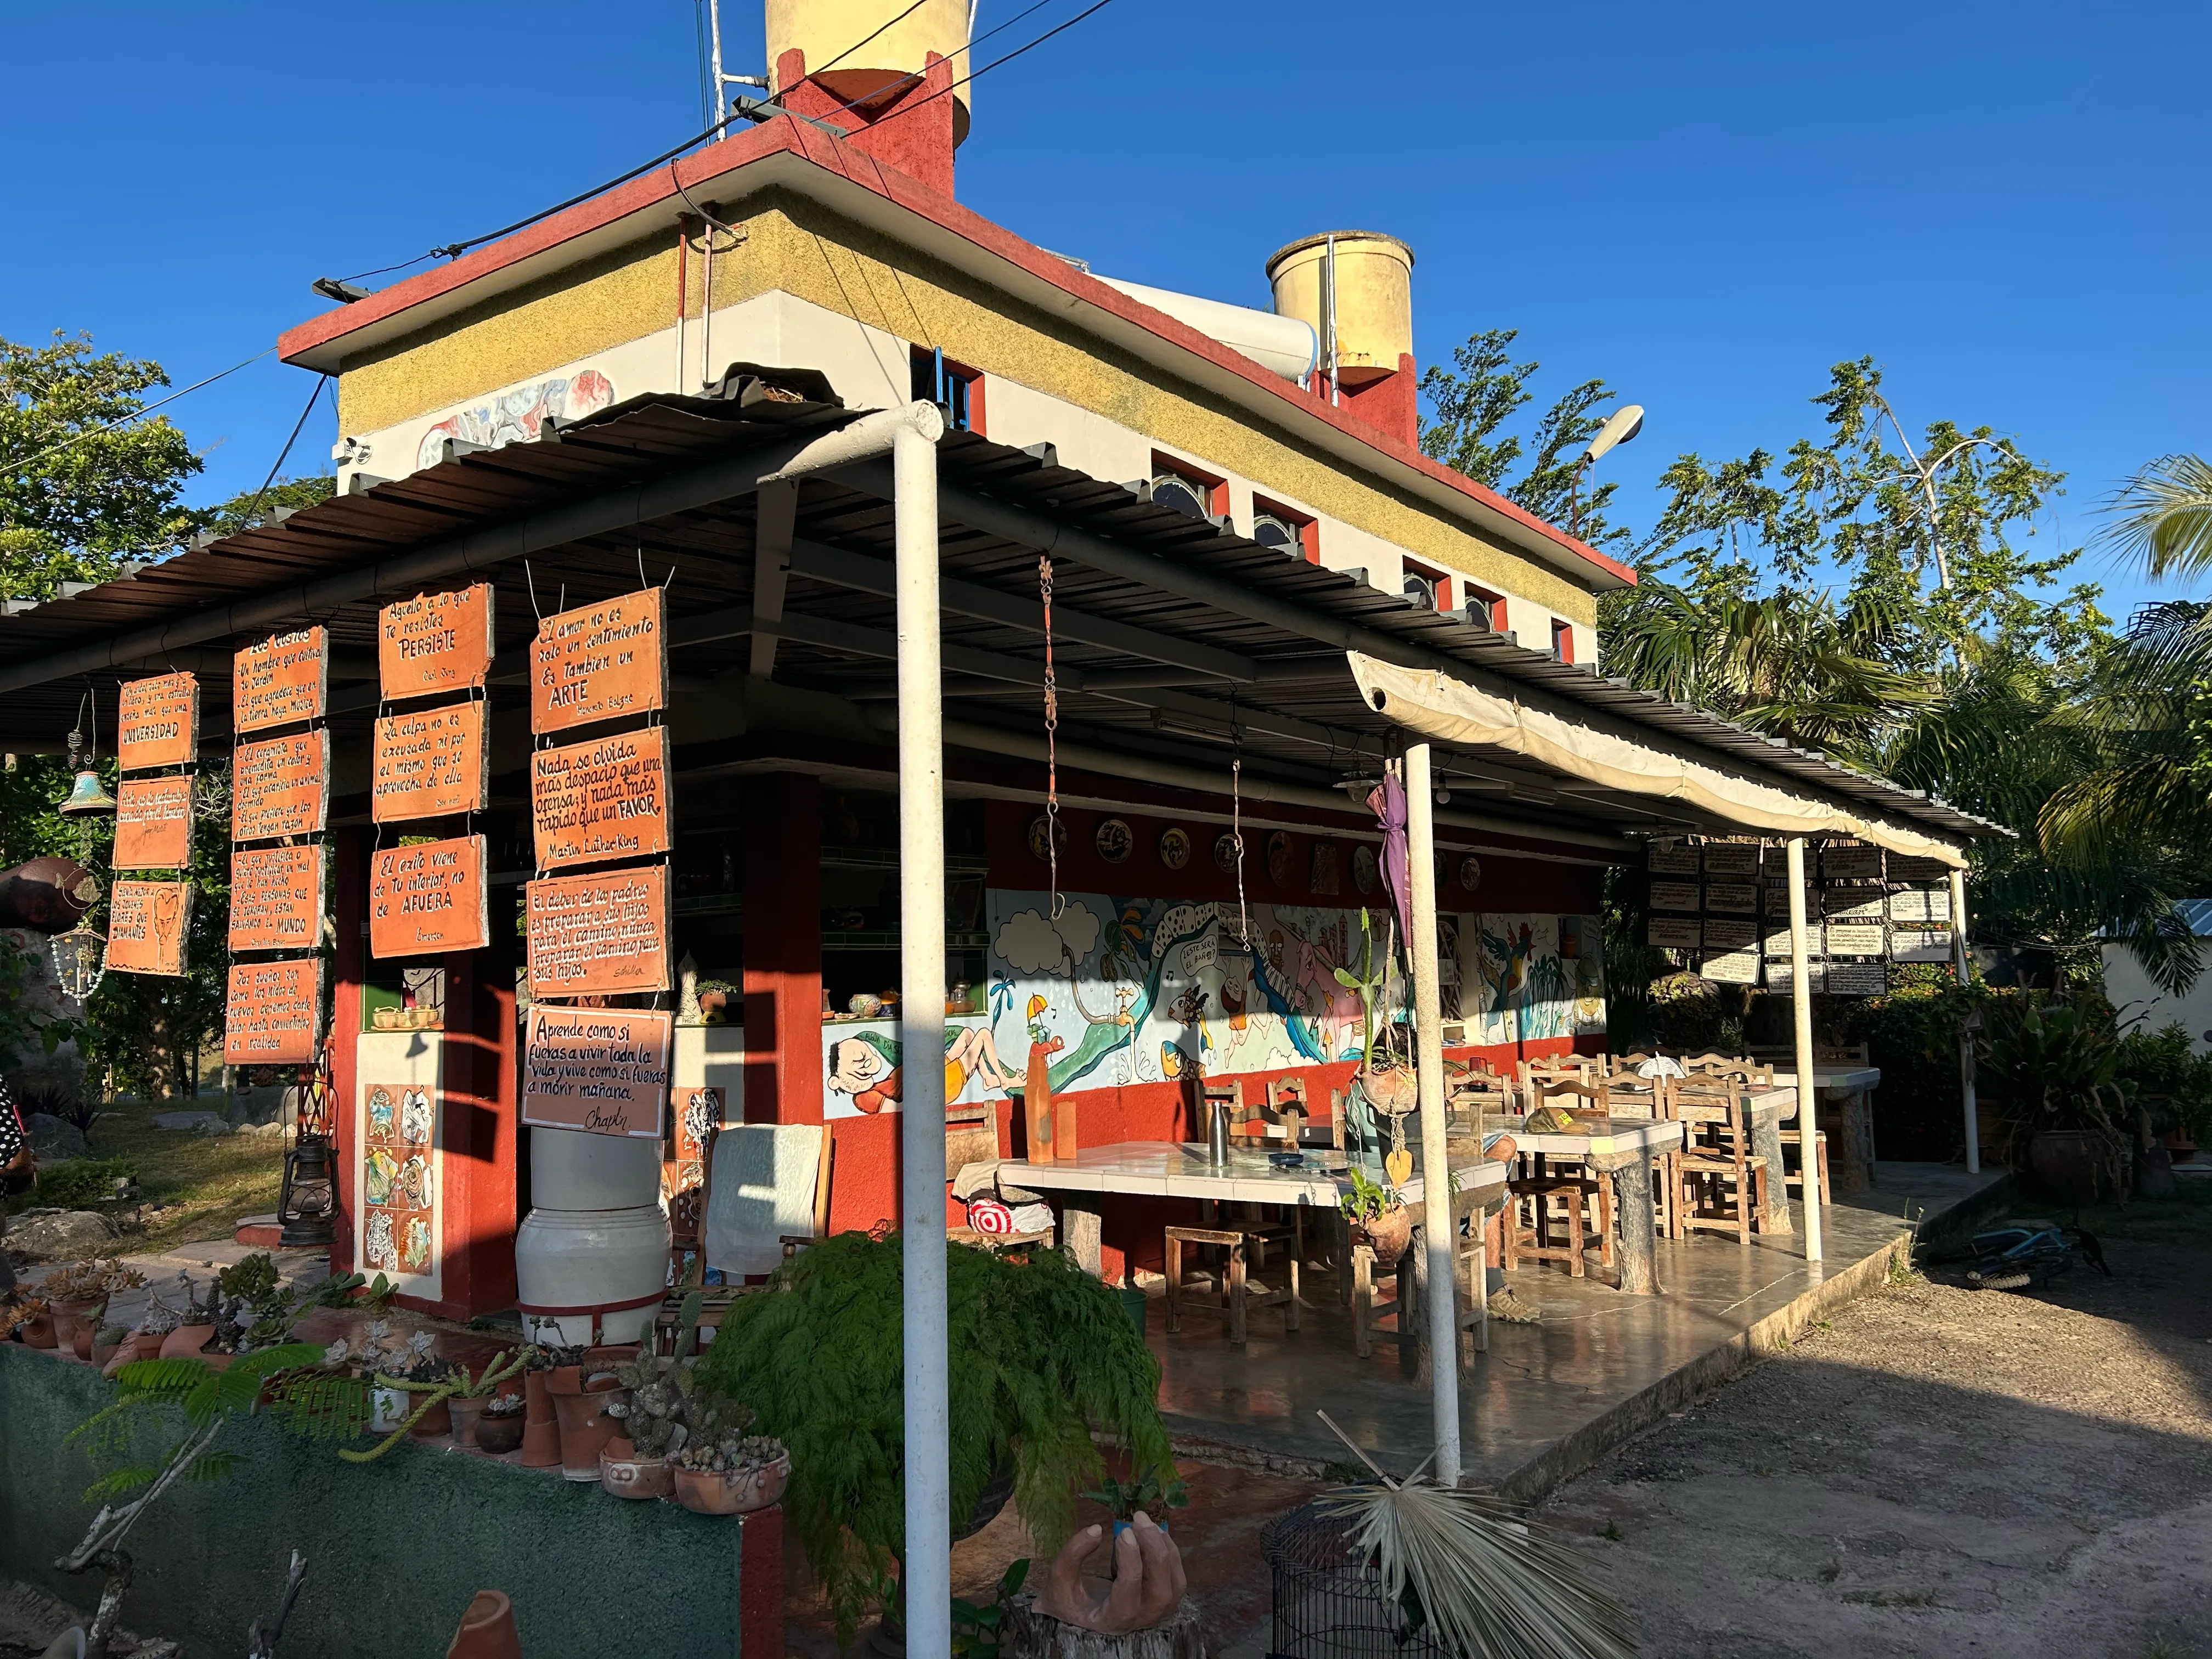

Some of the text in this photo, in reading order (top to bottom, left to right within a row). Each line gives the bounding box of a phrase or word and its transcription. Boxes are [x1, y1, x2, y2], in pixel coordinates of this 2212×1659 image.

[388, 591, 470, 622] Aquello a lo que
[402, 612, 443, 635] resistes
[557, 618, 585, 639] amor
[590, 613, 603, 628] no
[608, 608, 621, 624] es
[397, 629, 455, 661] PERSISTE
[538, 616, 653, 663] solo un sentimiento
[253, 653, 296, 674] hombre que
[423, 667, 455, 682] Carl Jung
[541, 667, 555, 687] Es
[618, 651, 633, 665] un
[251, 694, 262, 708] que
[264, 684, 293, 706] agradece
[296, 684, 306, 696] que
[548, 679, 589, 710] ARTE
[174, 703, 188, 713] una
[240, 704, 287, 724] la tierra haya
[122, 722, 178, 745] UNIVERSIDAD
[400, 716, 427, 739] culpa
[430, 719, 442, 731] no
[449, 714, 459, 727] es
[256, 741, 307, 759] ceramista que
[381, 732, 465, 759] excusada ni por
[276, 757, 285, 769] un
[286, 755, 304, 766] color
[305, 754, 311, 767] y
[394, 759, 425, 776] mismo
[431, 755, 447, 772] que
[452, 751, 462, 765] se
[537, 741, 636, 778] Nada se olvida
[239, 771, 277, 787] una forma
[375, 768, 461, 800] aprovecha de ella
[536, 758, 661, 796] más despacio que una
[581, 792, 587, 811] y
[591, 780, 624, 804] nada
[627, 775, 656, 795] más
[579, 807, 600, 834] que
[602, 804, 617, 820] un
[617, 794, 661, 820] FAVOR.
[583, 834, 616, 854] Luther
[616, 833, 639, 850] King
[431, 850, 458, 867] viene
[294, 888, 307, 900] QUE
[373, 881, 385, 899] de
[407, 871, 448, 891] interior,
[450, 871, 465, 885] no
[533, 879, 648, 912] El deber de los padres
[376, 891, 453, 919] de AFUERA
[111, 911, 148, 924] FLORES QUE
[230, 918, 261, 930] SALVANDO
[275, 917, 306, 935] MUNDO
[531, 902, 649, 936] es preparar a sus hijos
[112, 924, 145, 940] DIAMANTES
[416, 927, 444, 943] Emerson
[532, 934, 559, 956] para
[561, 929, 571, 948] el
[619, 922, 658, 939] nunca
[534, 937, 660, 973] preparar el camino para
[1186, 960, 1193, 970] EL
[255, 968, 299, 984] sueños son
[534, 961, 587, 985] sus hijos.
[254, 980, 298, 1000] los nidos de
[228, 995, 311, 1018] huevos darle
[247, 1012, 310, 1032] hasta convertirlos
[536, 1014, 630, 1047] Aprende como si
[231, 1034, 281, 1051] en realidad
[527, 1042, 652, 1067] fueras a vivir toda la
[532, 1061, 666, 1085] vida y vive como si fueras
[527, 1080, 635, 1102] a morir mañana.
